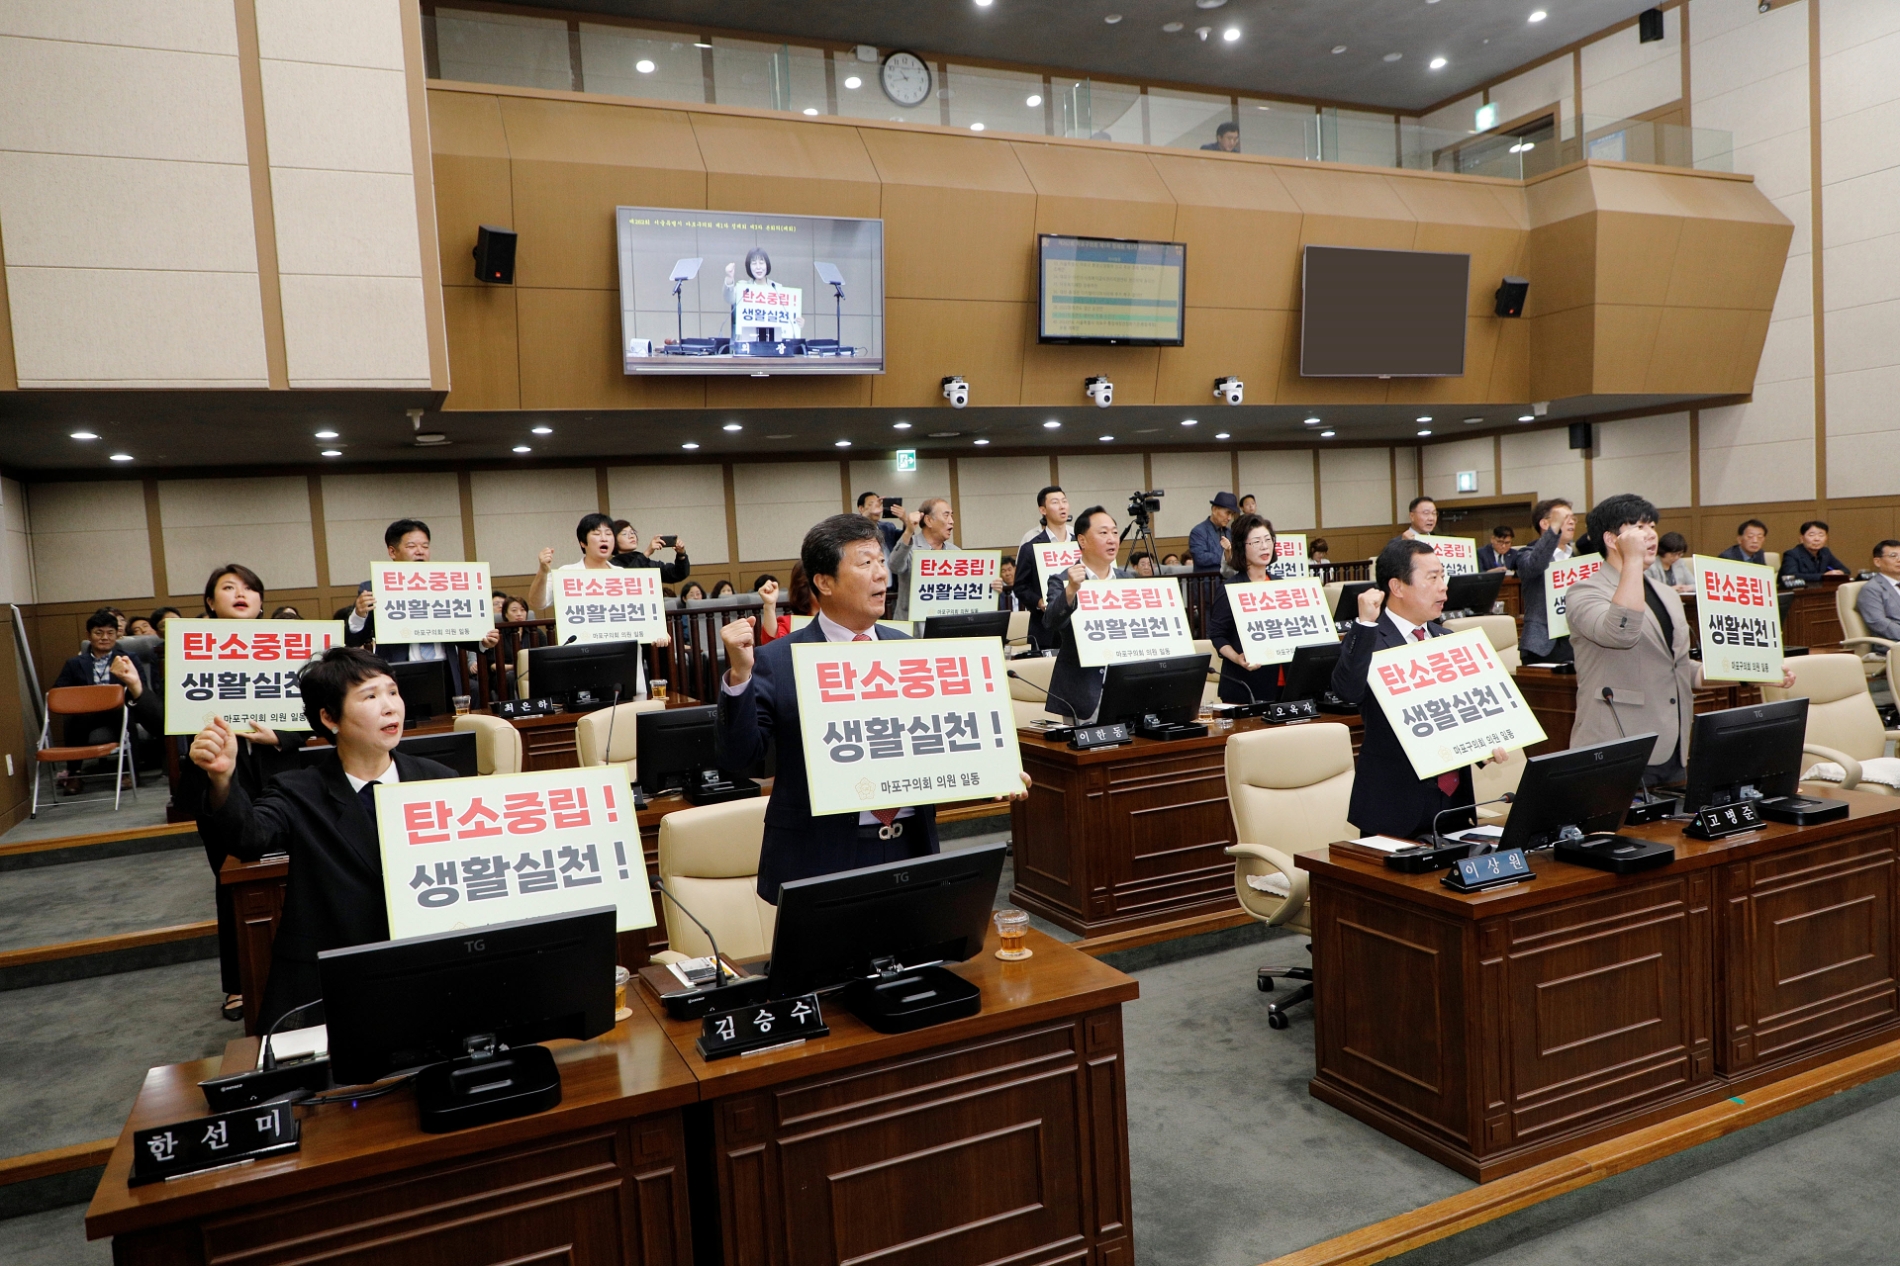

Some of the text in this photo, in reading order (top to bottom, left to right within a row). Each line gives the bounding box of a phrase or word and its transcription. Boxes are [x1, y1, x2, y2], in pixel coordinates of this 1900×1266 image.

[920, 559, 994, 576] 탄소중립!
[383, 571, 483, 591] 탄소중립!
[562, 577, 655, 597] 탄소중립!
[918, 583, 993, 601] 생활실천!
[1704, 570, 1773, 607] 탄소중립!
[384, 599, 486, 620] 생활실천!
[1077, 588, 1176, 611] 탄소중립!
[1238, 587, 1320, 613] 탄소중립!
[565, 603, 658, 624] 생활실천!
[1083, 617, 1183, 641] 생활실천!
[1246, 614, 1330, 641] 생활실천!
[1708, 614, 1778, 648] 생활실천!
[815, 656, 995, 703] 탄소중립!
[1376, 643, 1494, 696] 탄소중립!
[223, 713, 267, 724] 마포구의회
[270, 712, 287, 723] 의원
[1401, 681, 1518, 738] 생활실천!
[1753, 709, 1763, 718] TG
[822, 711, 1005, 763] 생활실천!
[1453, 728, 1515, 756] 마포구의회 의원 일동
[1593, 751, 1604, 761] TG
[881, 772, 980, 794] 마포구의회 의원 일동
[402, 784, 619, 846] 탄소중립!
[408, 841, 630, 909] 생활실천!
[893, 871, 910, 884] TG
[464, 938, 486, 953] TG
